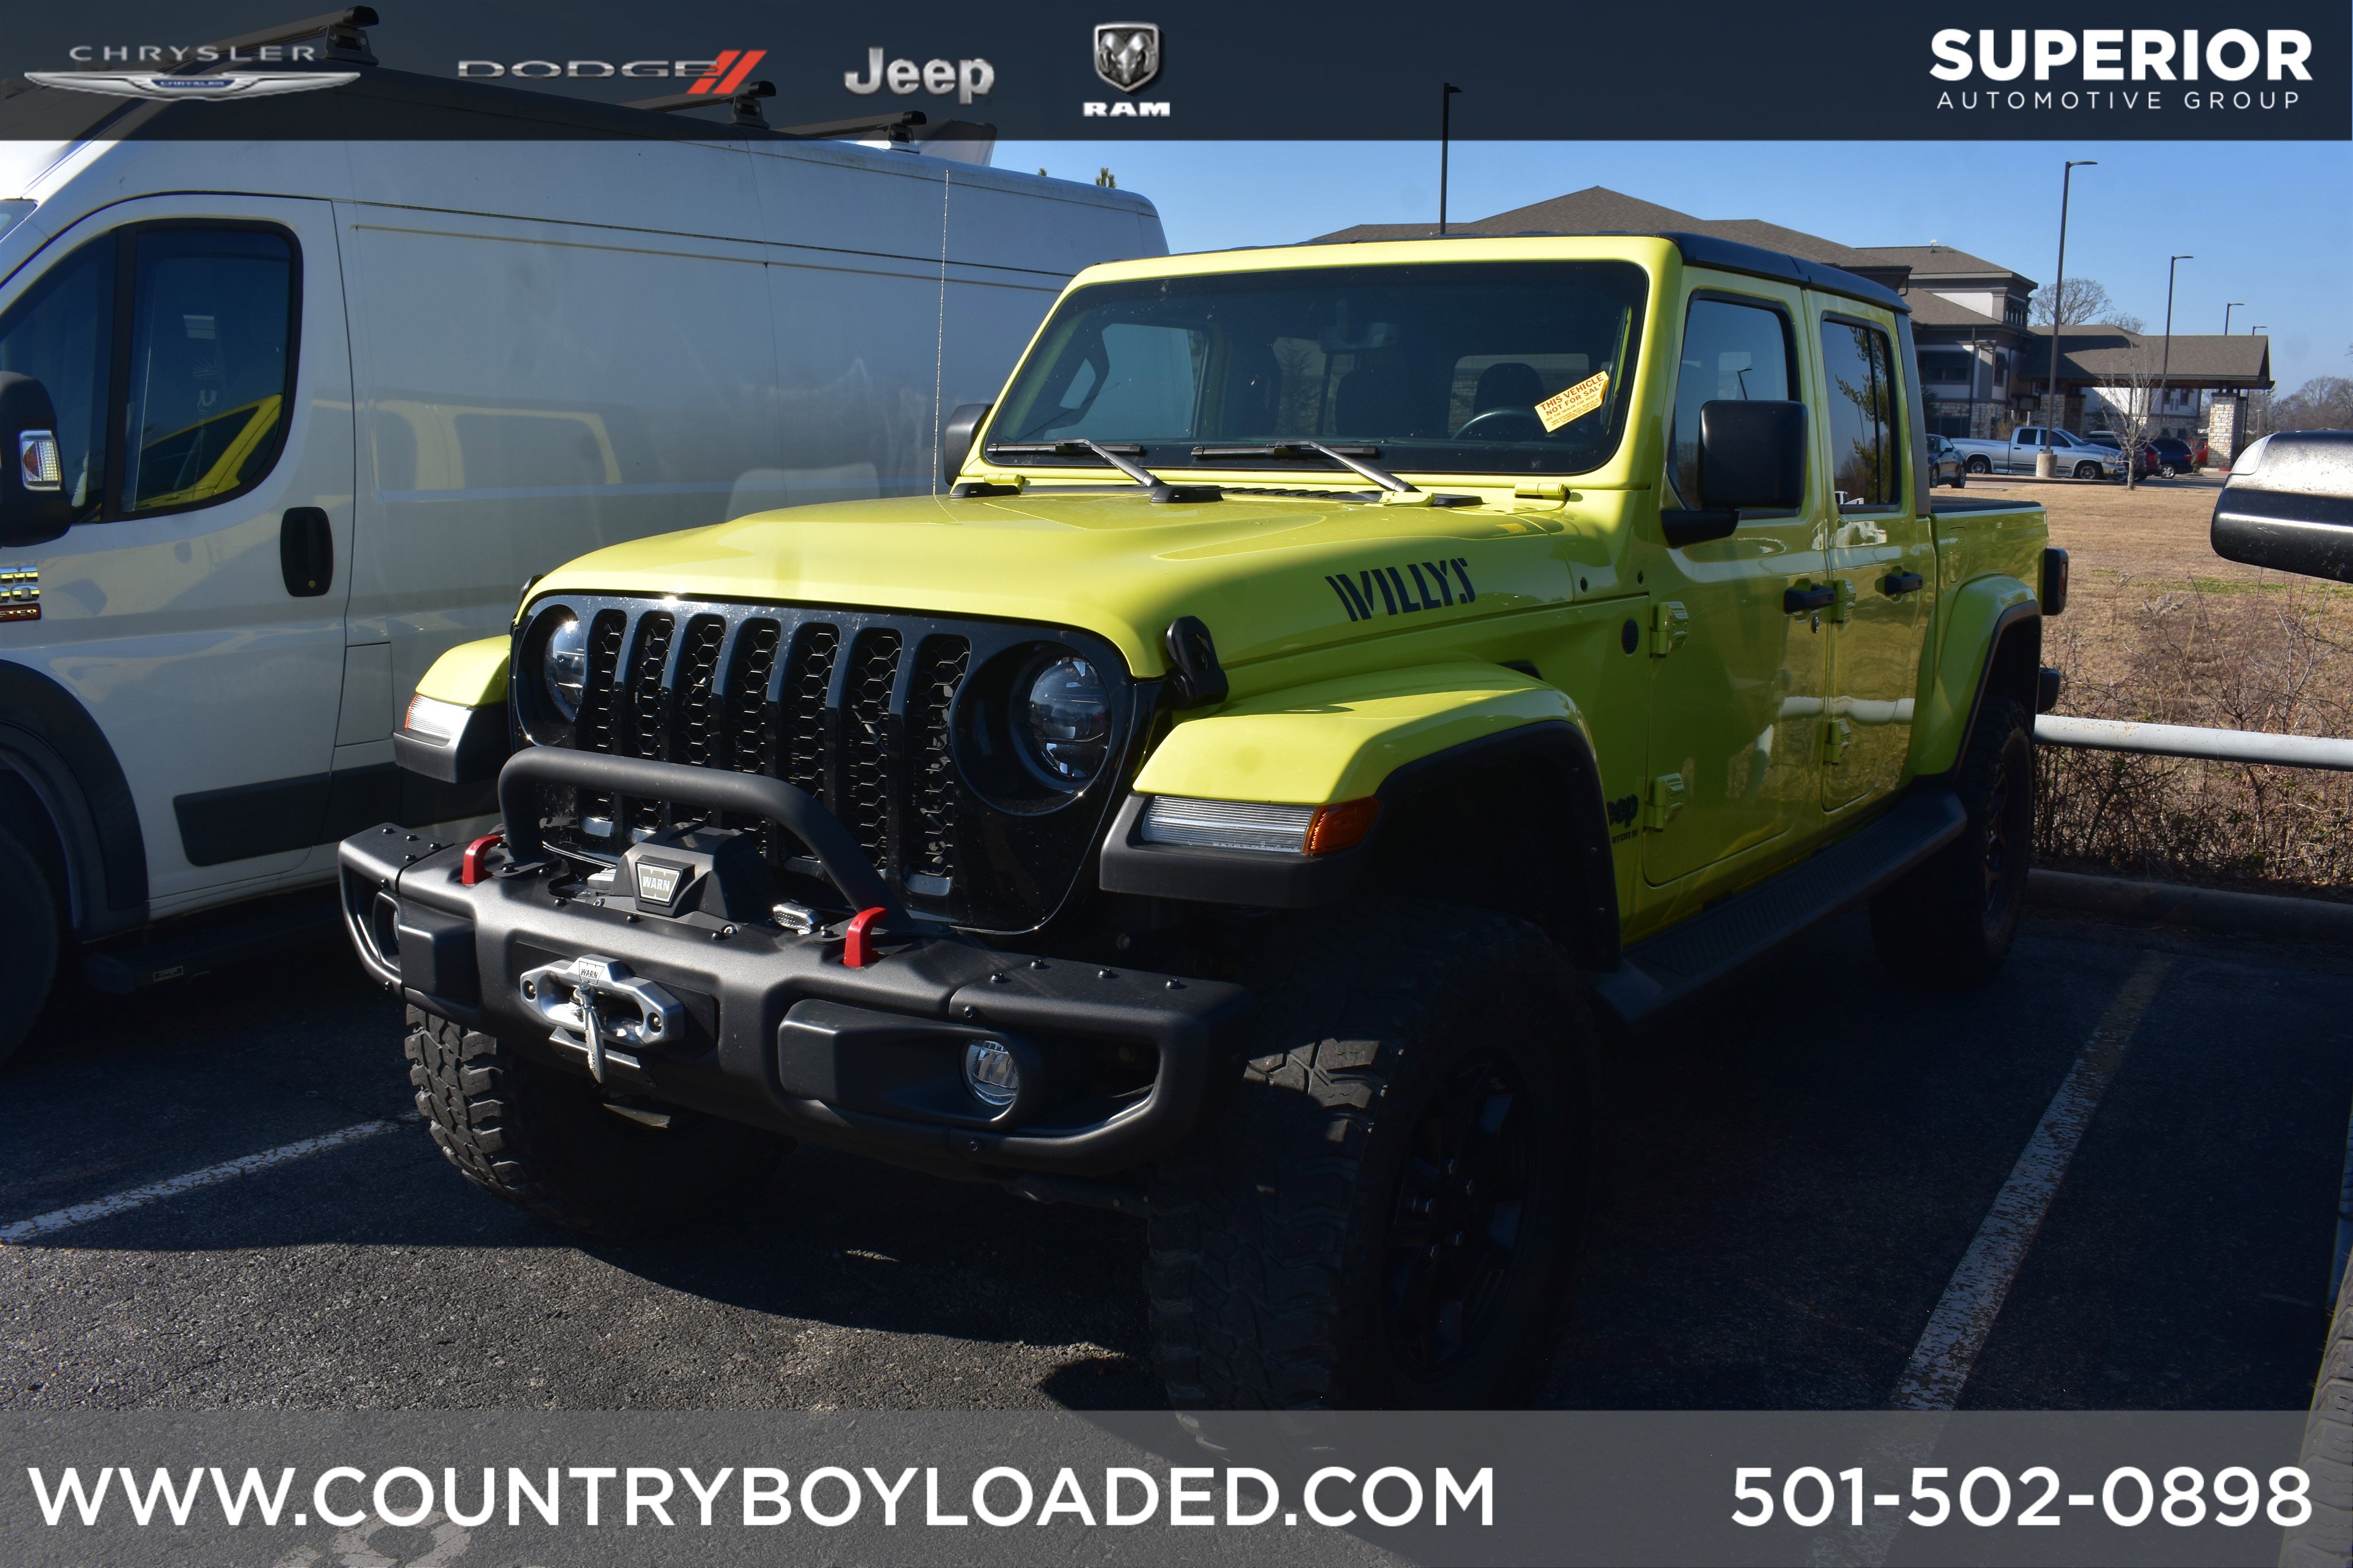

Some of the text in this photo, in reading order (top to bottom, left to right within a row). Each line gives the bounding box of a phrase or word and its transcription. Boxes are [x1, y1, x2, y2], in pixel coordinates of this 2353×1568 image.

[1540, 374, 1603, 410] THIS VEHICLE
[1546, 403, 1562, 415] NOT
[1564, 395, 1581, 405] FOR
[1324, 558, 1475, 621] WILLYS
[642, 875, 670, 891] WARN
[581, 968, 599, 979] WARN
